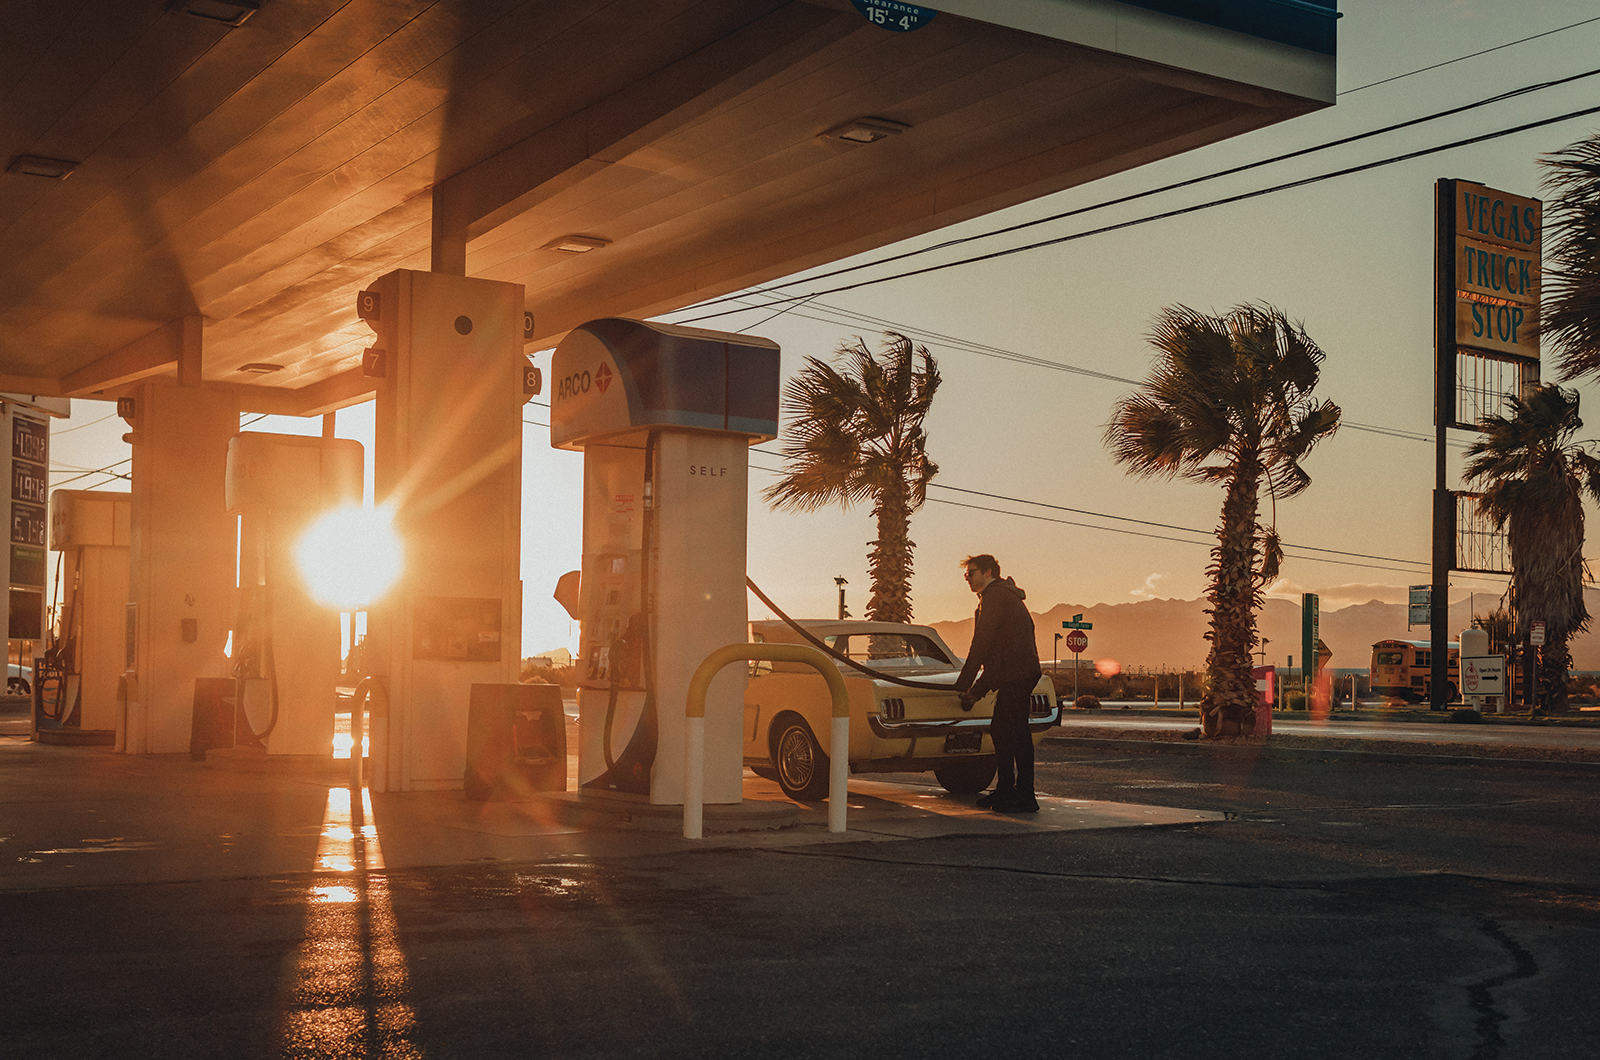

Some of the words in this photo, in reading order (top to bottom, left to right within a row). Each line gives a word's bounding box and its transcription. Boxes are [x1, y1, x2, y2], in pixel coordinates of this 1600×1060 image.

[1463, 191, 1535, 245] VEGAS
[1463, 245, 1533, 298] TRUCK
[363, 295, 374, 312] 9
[1471, 301, 1524, 344] STOP
[369, 353, 380, 369] 7
[526, 371, 536, 387] 8
[557, 369, 591, 401] ARCO
[120, 400, 130, 413] 11
[690, 464, 727, 477] SELF
[1068, 637, 1087, 646] STOP
